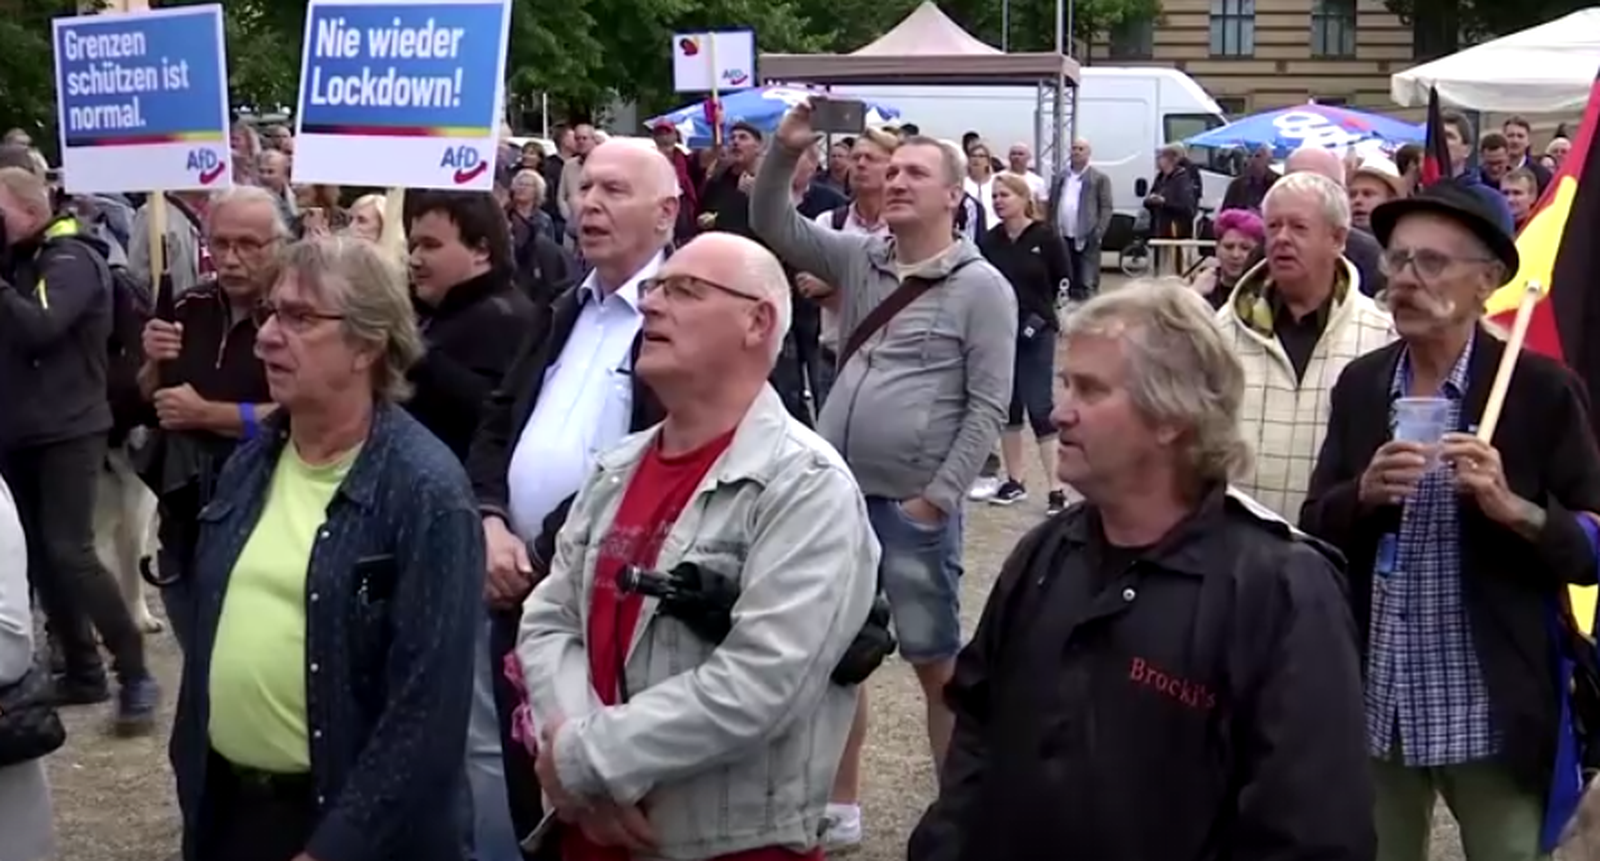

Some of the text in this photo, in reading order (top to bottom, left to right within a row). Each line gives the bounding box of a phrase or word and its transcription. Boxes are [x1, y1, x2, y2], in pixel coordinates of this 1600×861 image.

[65, 30, 145, 61] Grenzen
[315, 18, 464, 58] Nie wieder
[68, 56, 189, 95] schützen ist
[311, 66, 462, 107] Lockdown!
[70, 96, 146, 130] normal.
[186, 149, 217, 171] AfD
[440, 145, 479, 169] AfD
[1130, 657, 1216, 708] Brocki's
